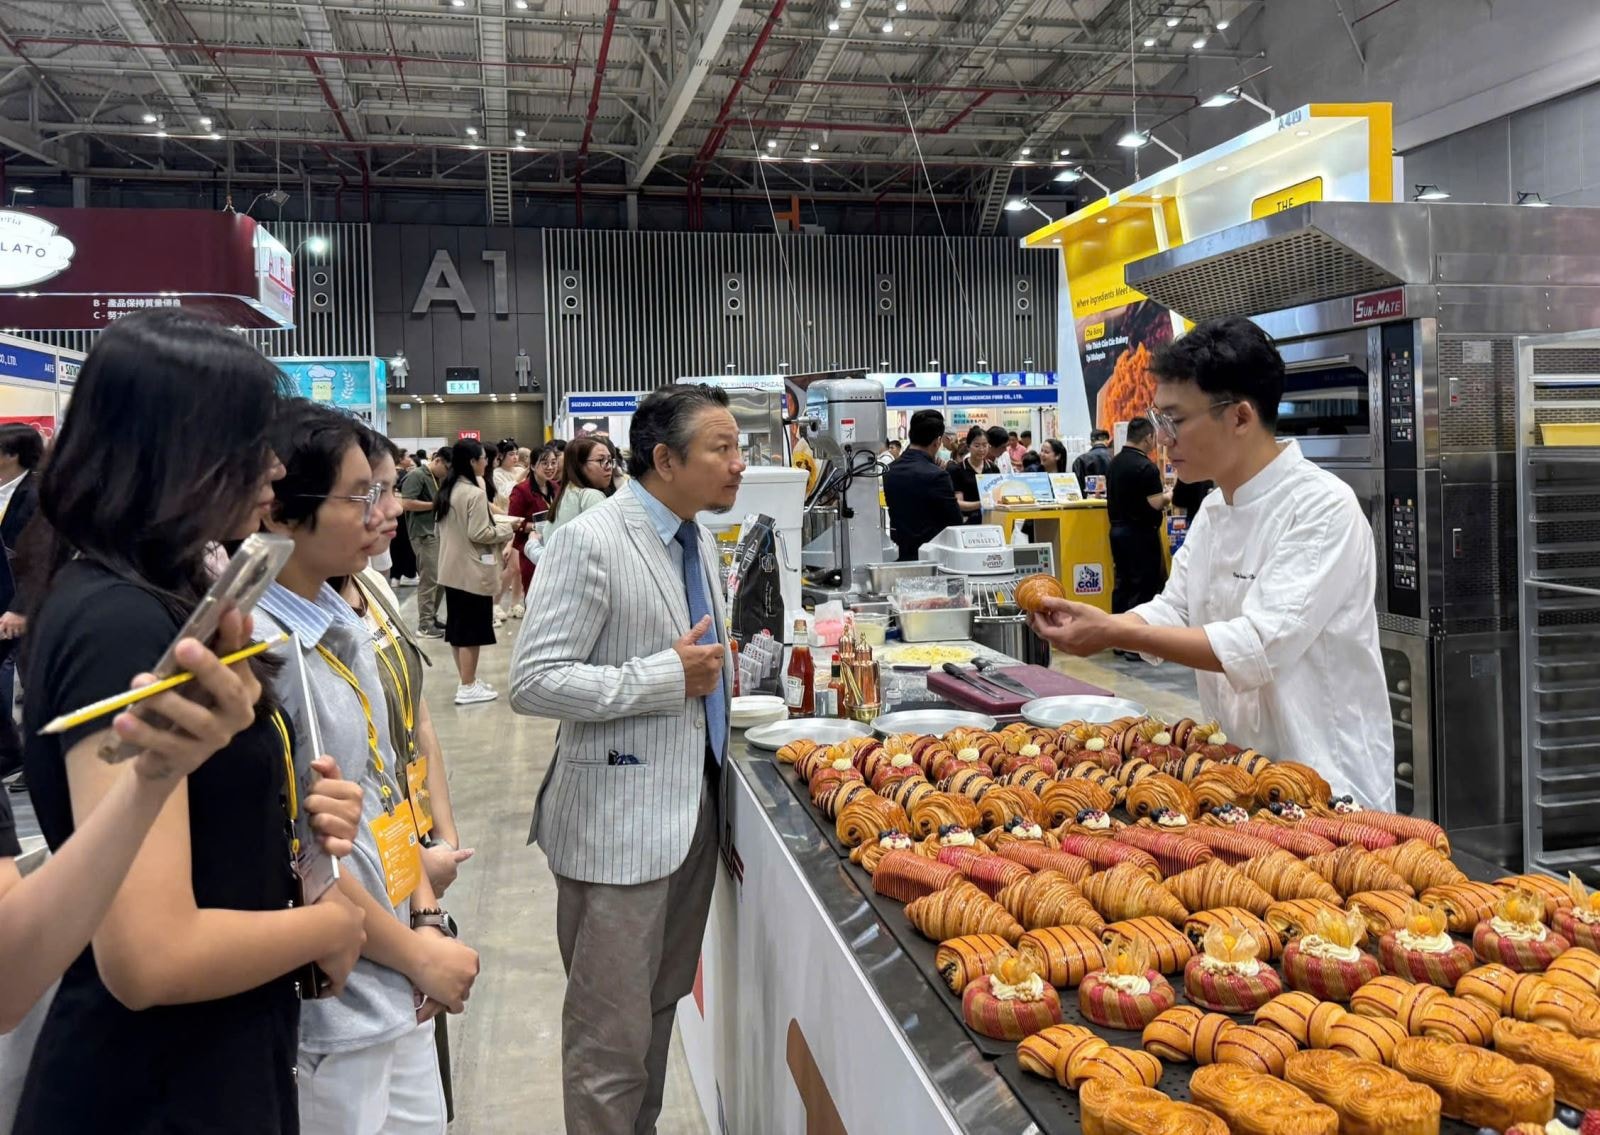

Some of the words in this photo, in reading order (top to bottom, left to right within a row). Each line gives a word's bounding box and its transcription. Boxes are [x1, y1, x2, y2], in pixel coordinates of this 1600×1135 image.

[411, 249, 510, 314] A1
[93, 299, 100, 307] B
[1355, 300, 1402, 319] SUN-MATE
[93, 311, 100, 319] C
[450, 382, 478, 392] EXIT
